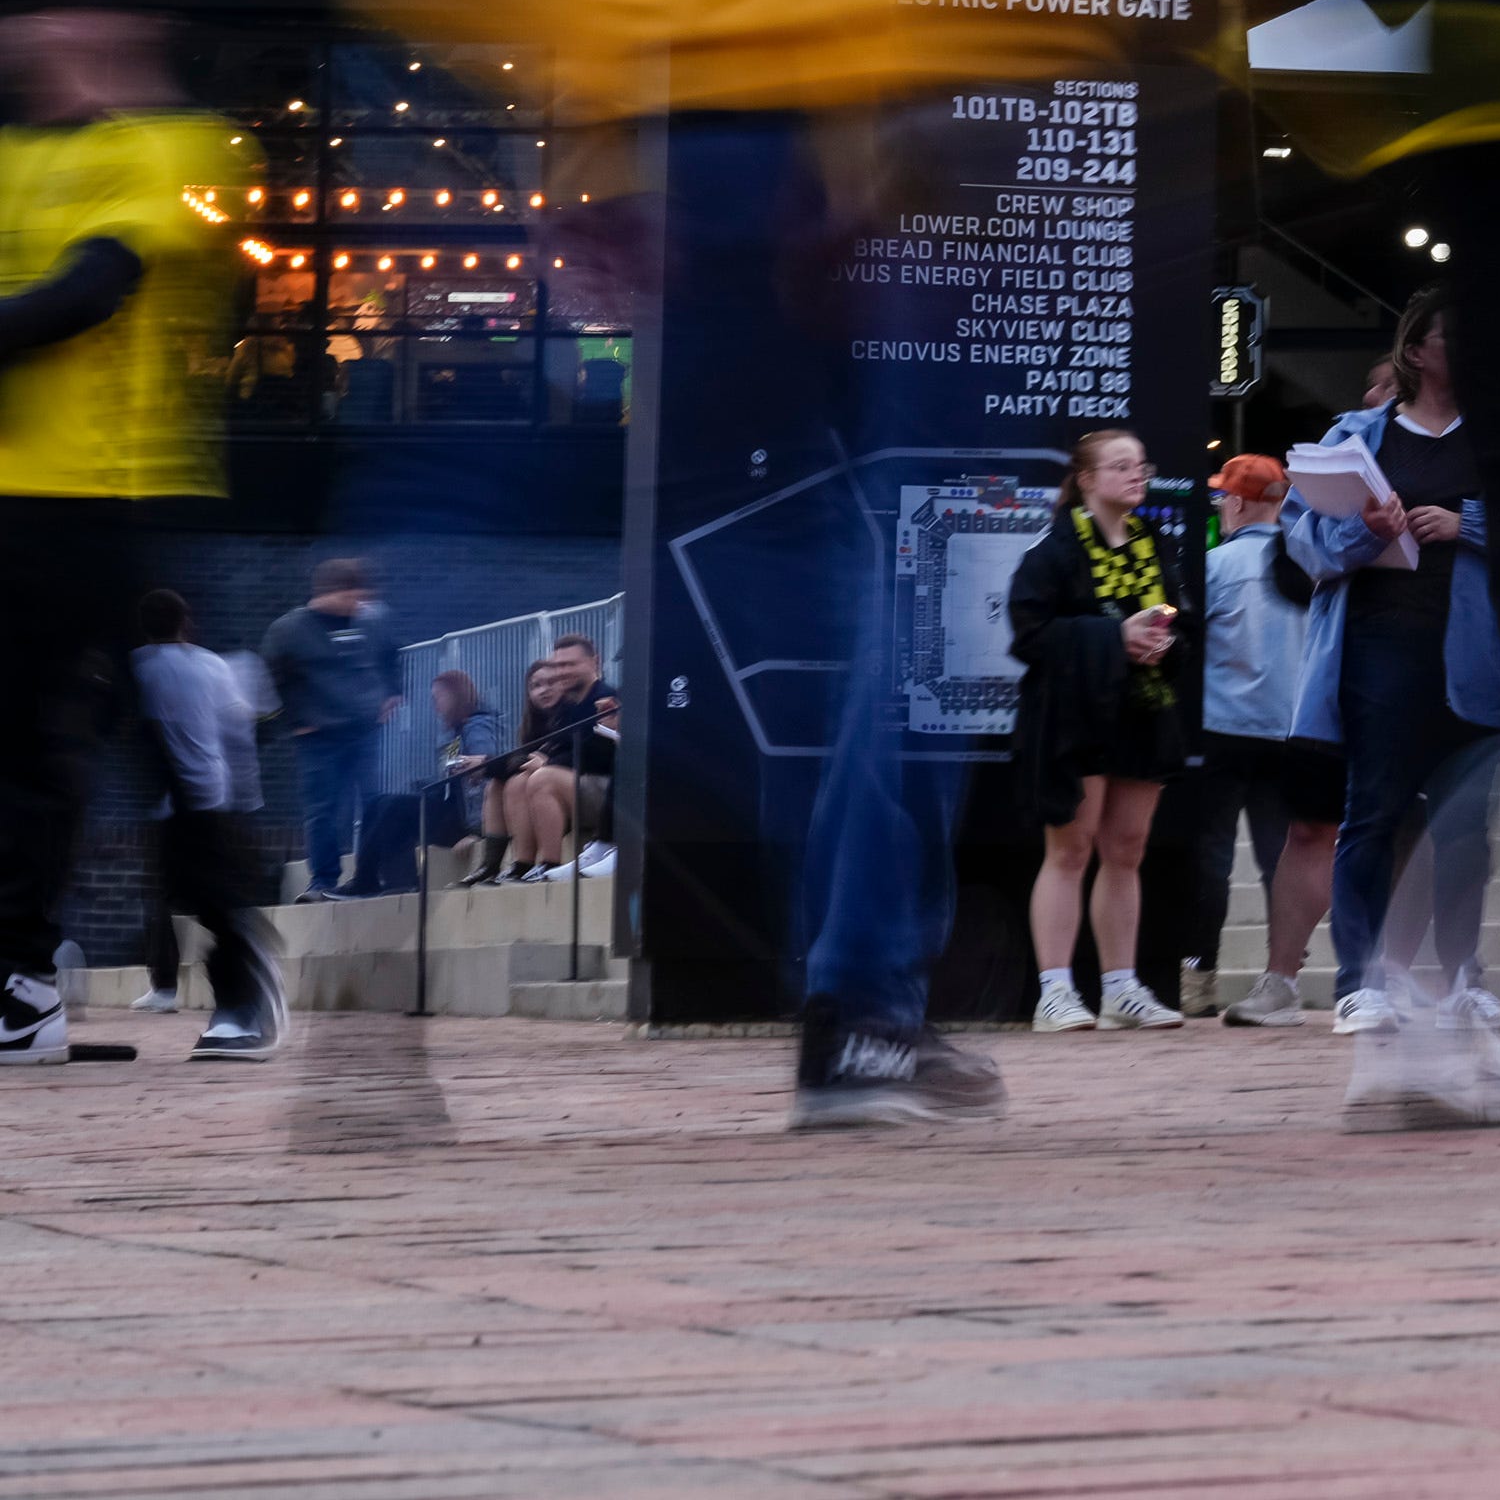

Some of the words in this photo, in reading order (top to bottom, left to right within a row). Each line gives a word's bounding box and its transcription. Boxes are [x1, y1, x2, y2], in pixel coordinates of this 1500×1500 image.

[1054, 80, 1139, 99] SECTIONS
[952, 96, 1138, 127] 101TB-102TB
[1027, 128, 1138, 156] 110-131
[1016, 157, 1137, 186] 209-244
[997, 194, 1064, 215] CREW
[1071, 197, 1135, 219] SHOP
[901, 214, 1036, 239] LOWER.COM
[1044, 219, 1134, 243] LOUNGE
[855, 239, 932, 259] BREAD
[943, 241, 1066, 266] FINANCIAL
[1072, 245, 1133, 267] CLUB
[901, 265, 992, 287] ENERGY
[1001, 268, 1065, 290] FIELD
[1072, 269, 1134, 292] CLUB
[972, 294, 1049, 315] CHASE
[1056, 295, 1134, 319] PLAZA
[956, 318, 1065, 340] SKYVIEW
[1071, 320, 1132, 344] CLUB
[852, 340, 961, 362] CENOVUS
[970, 343, 1062, 367] ENERGY
[1068, 346, 1132, 369] ZONE
[1026, 370, 1094, 392] PATIO
[985, 395, 1060, 416] PARTY
[1067, 396, 1131, 419] DECK
